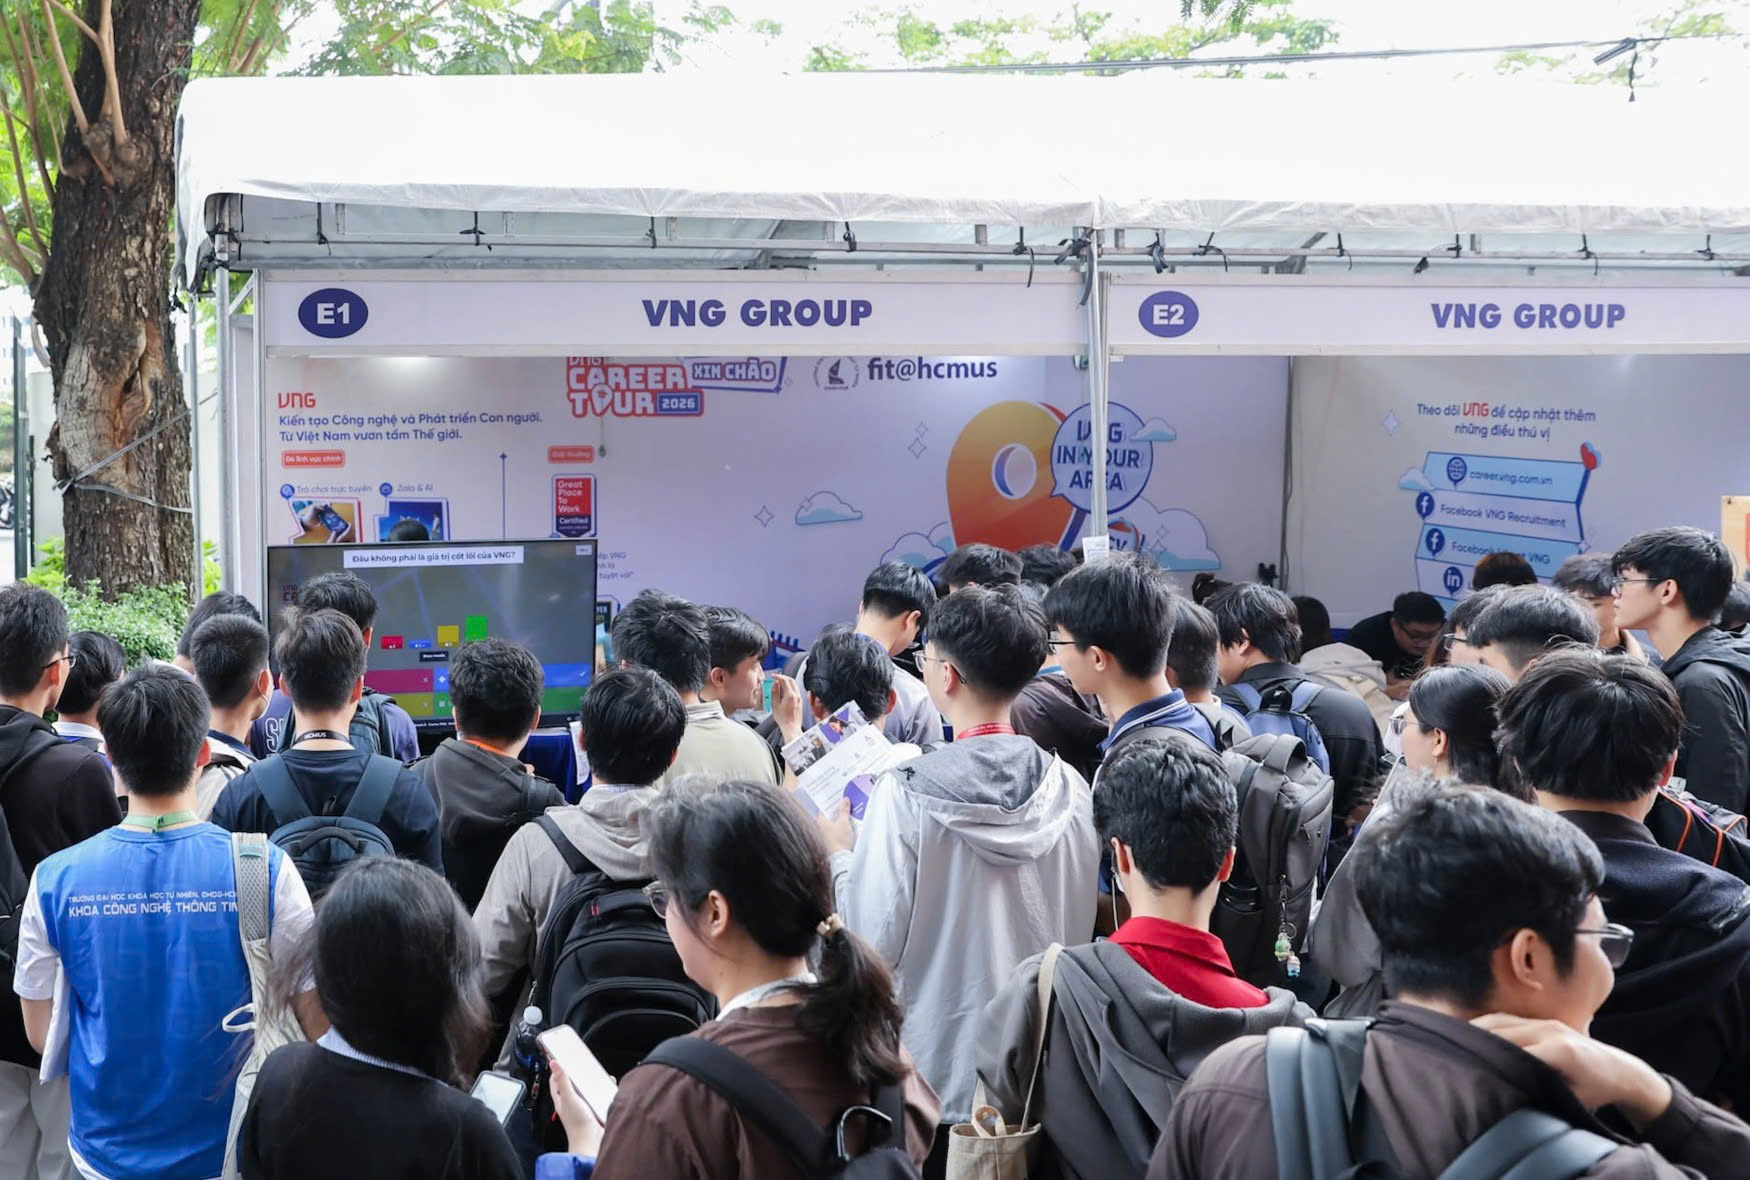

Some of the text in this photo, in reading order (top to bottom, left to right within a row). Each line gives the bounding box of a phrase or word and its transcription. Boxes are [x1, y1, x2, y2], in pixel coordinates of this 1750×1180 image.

[317, 303, 350, 324] E1
[643, 299, 873, 327] VNG GROUP
[1153, 305, 1184, 325] E2
[1432, 303, 1625, 328] VNG GROUP
[694, 364, 721, 379] XIN
[868, 357, 997, 381] fit@hcmus
[569, 367, 685, 390] CAREER
[278, 393, 316, 408] VNG
[569, 391, 696, 415] TOUR 2026
[279, 412, 542, 428] Kiến tạo Công nghệ và Phát triển Con người.
[1417, 403, 1441, 416] Theo
[1444, 405, 1460, 417] dõi
[1463, 402, 1489, 417] VNG
[1508, 408, 1530, 422] cập
[1533, 408, 1561, 422] nhật
[1564, 409, 1596, 422] thêm
[279, 429, 462, 443] Từ Việt Nam vươn tầm Thế giới.
[1077, 420, 1122, 443] VG
[1454, 424, 1551, 442] những điều thú vị
[1057, 445, 1076, 465] IN
[558, 480, 584, 489] Great
[1069, 470, 1123, 491] ARA
[1469, 470, 1553, 486] career.vng.com.vn
[397, 484, 415, 493] Zalo
[558, 489, 583, 497] Place
[558, 497, 568, 505] To
[558, 505, 581, 514] Work
[559, 516, 588, 525] Certified
[1440, 504, 1567, 529] Facebook VNG Recruitment
[371, 554, 396, 564] không
[400, 553, 416, 563] phải
[418, 553, 425, 561] là
[427, 553, 439, 563] giá
[451, 552, 464, 561] cốt
[477, 552, 492, 560] của
[494, 551, 516, 560] VNG?
[1529, 553, 1550, 565] VNG
[1447, 570, 1461, 585] in
[69, 900, 238, 918] KHOA CÔNG NGHỆ THÔNG TIN
